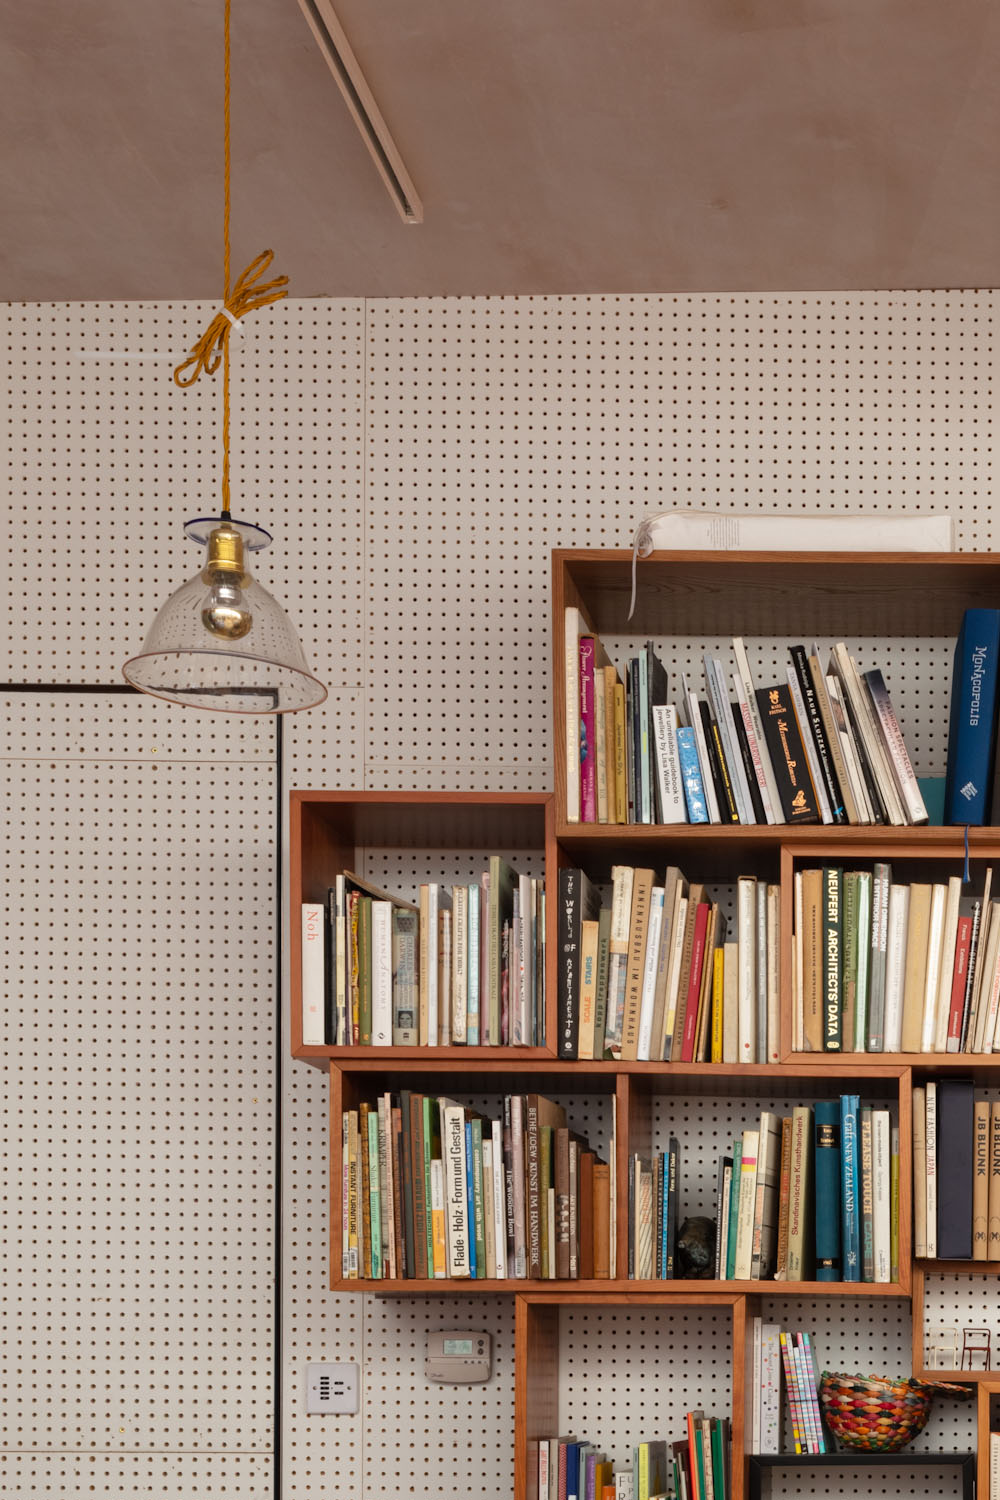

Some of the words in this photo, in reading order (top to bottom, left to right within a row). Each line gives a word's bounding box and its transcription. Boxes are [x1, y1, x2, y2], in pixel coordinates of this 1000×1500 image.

[970, 645, 988, 726] MONACOPOLIS
[657, 708, 668, 742] jewellery
[664, 709, 672, 720] An
[806, 689, 818, 716] NAUM
[813, 717, 828, 756] SLUTZKY
[660, 742, 668, 752] by
[665, 720, 676, 756] unreliable
[661, 753, 670, 768] Lisa
[668, 757, 678, 796] guidebook
[663, 770, 672, 794] Walker
[673, 796, 680, 804] to
[828, 870, 838, 924] NEUFERT
[307, 911, 320, 942] Noh
[633, 884, 646, 962] INNENAUSBAU
[631, 968, 638, 980] IM
[828, 928, 840, 1004] ARCHITECTS'
[627, 987, 638, 1046] WOHNHAUS
[828, 1004, 838, 1036] DATA
[927, 1096, 936, 1114] NEW
[450, 1117, 464, 1154] Gestalt
[844, 1113, 856, 1140] Craft
[926, 1117, 934, 1152] FASHION
[977, 1116, 986, 1130] JB
[378, 1129, 386, 1168] KRIMPER
[844, 1141, 854, 1164] NEW
[862, 1120, 872, 1170] PLEASE
[977, 1134, 986, 1176] BLUNK
[451, 1156, 462, 1178] und
[473, 1149, 482, 1194] contemporary
[927, 1154, 936, 1176] JAPAN
[452, 1179, 464, 1204] Form
[845, 1165, 854, 1212] ZEALAND
[863, 1172, 874, 1214] TOUCH
[350, 1195, 358, 1234] FURNITURE
[453, 1210, 464, 1232] Holz
[453, 1239, 466, 1268] Flade
[864, 1220, 872, 1258] CAPE
